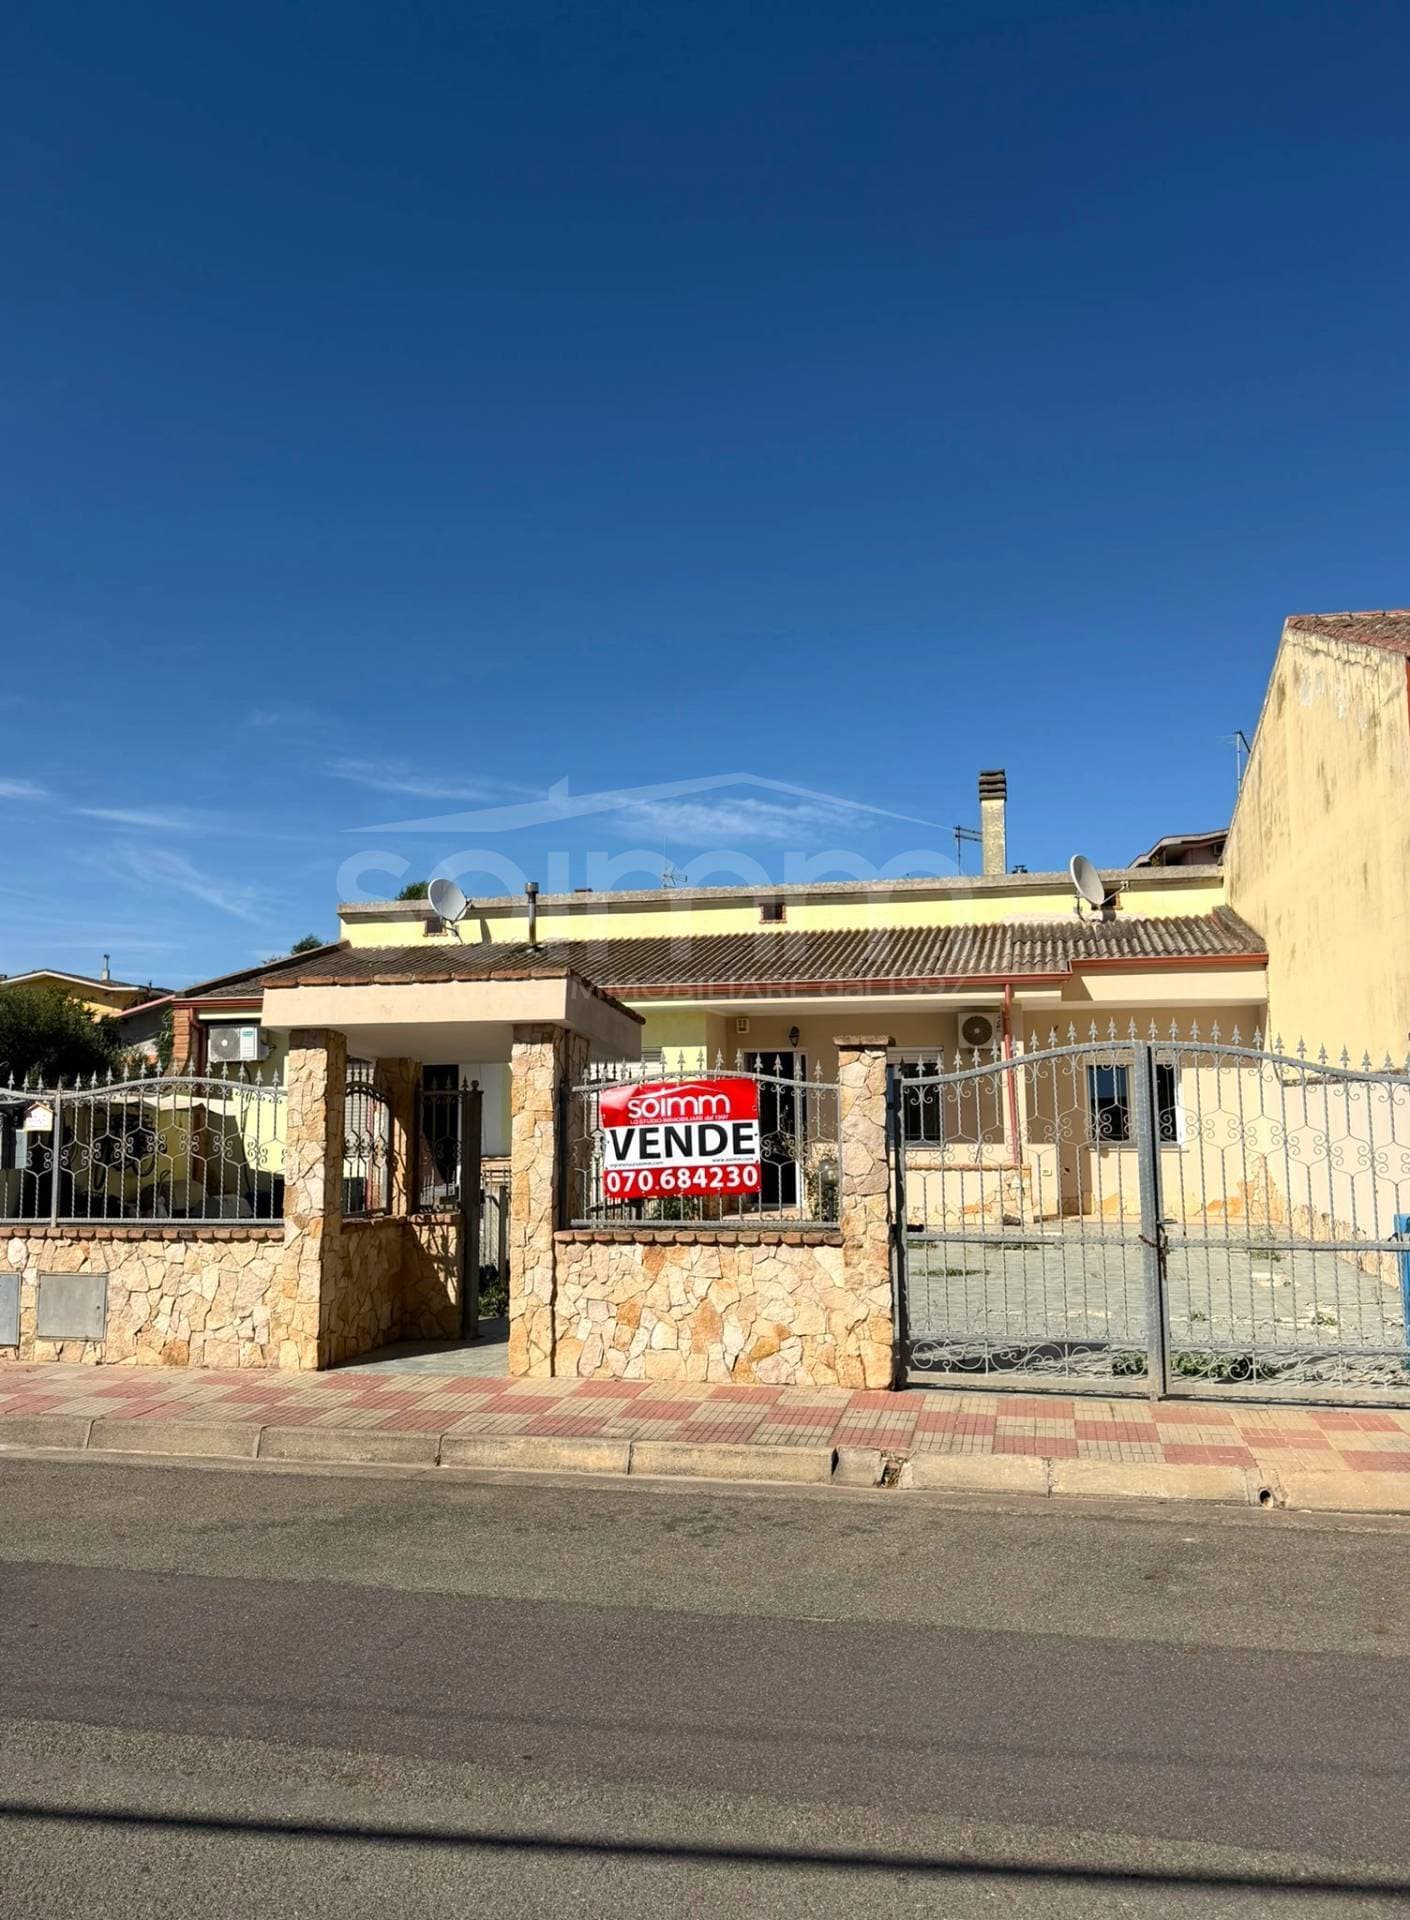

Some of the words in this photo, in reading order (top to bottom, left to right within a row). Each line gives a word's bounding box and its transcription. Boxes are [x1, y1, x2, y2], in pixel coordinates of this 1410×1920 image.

[627, 1093, 731, 1119] soimm
[609, 1122, 756, 1161] VENDE
[606, 1166, 758, 1193] 070.684230
